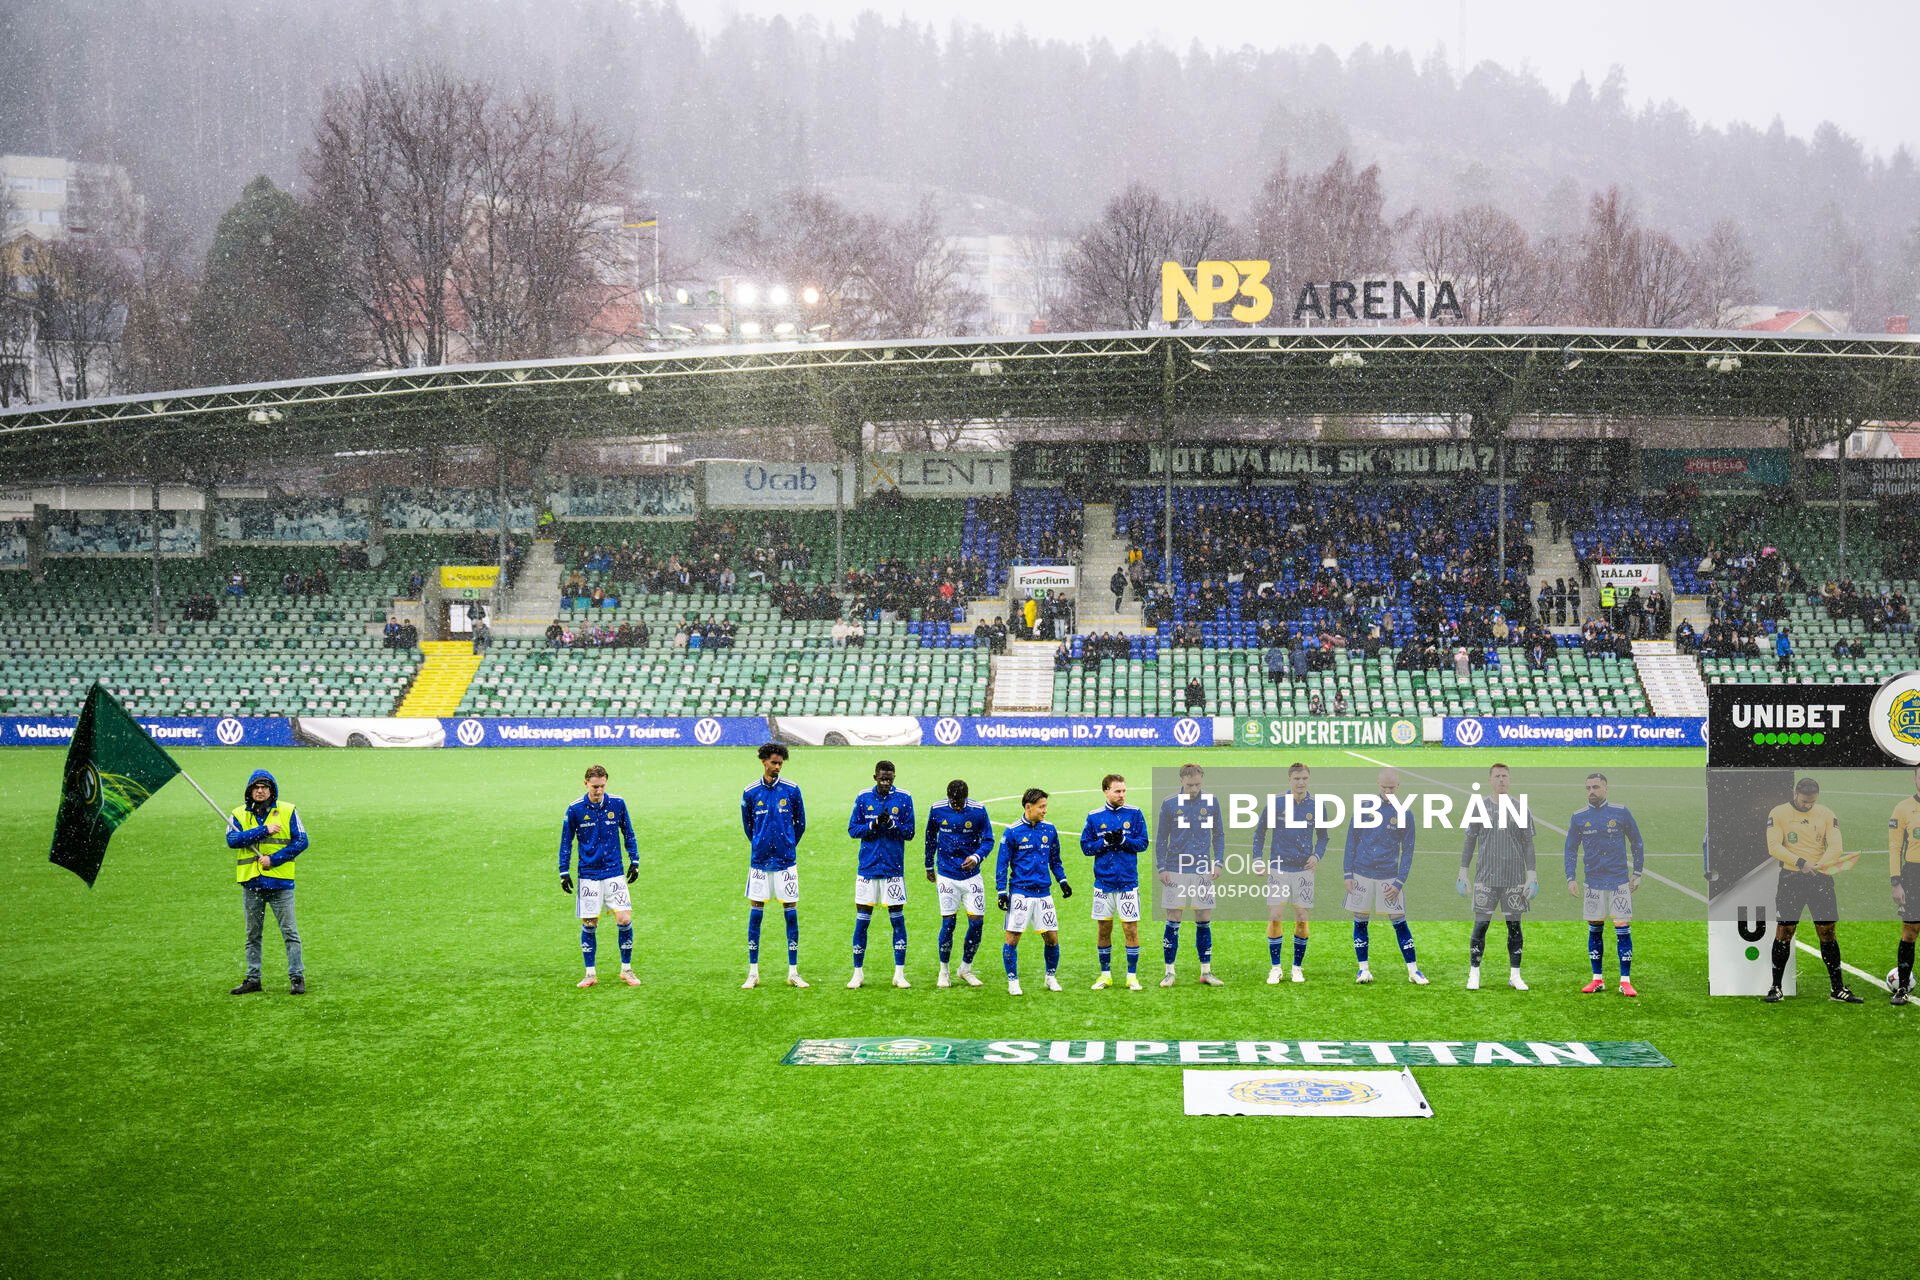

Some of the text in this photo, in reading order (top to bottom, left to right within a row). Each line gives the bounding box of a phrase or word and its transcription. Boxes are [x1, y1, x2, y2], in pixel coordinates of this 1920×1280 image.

[1162, 260, 1465, 323] NP3 ARENA
[743, 466, 817, 491] Ocab
[1020, 576, 1069, 585] Faradium
[1732, 704, 1845, 728] UNIBET
[17, 724, 202, 738] Volksw Tourer.
[498, 724, 681, 742] Volkswagen ID.7 Tourer.
[976, 724, 1159, 742] Volkswagen ID.7 Tourer.
[1270, 720, 1386, 744] SUPERETTAN
[1498, 724, 1685, 741] Volkswagen ID.7 Tourer.
[1738, 906, 1766, 942] U
[983, 1041, 1602, 1064] SUPERETTAN
